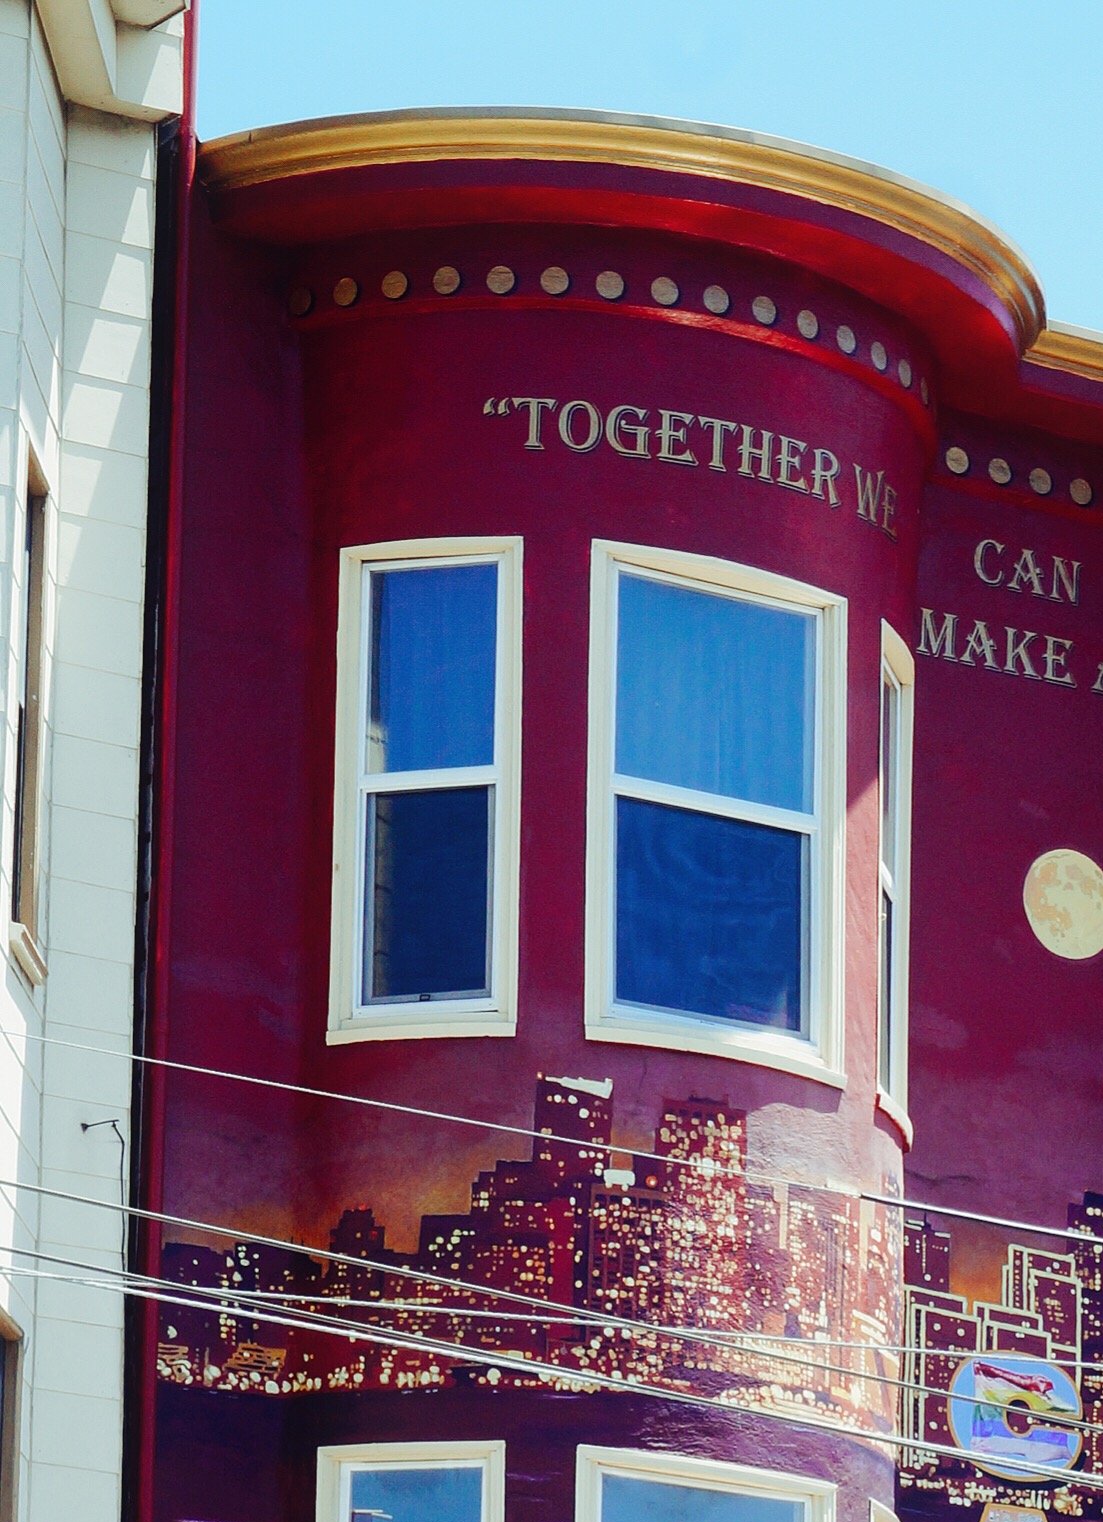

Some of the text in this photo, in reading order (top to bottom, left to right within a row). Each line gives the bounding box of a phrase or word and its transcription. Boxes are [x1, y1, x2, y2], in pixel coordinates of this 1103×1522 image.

[852, 462, 897, 543] WE
[973, 539, 1083, 606] CAN
[916, 607, 1078, 689] MAKE
